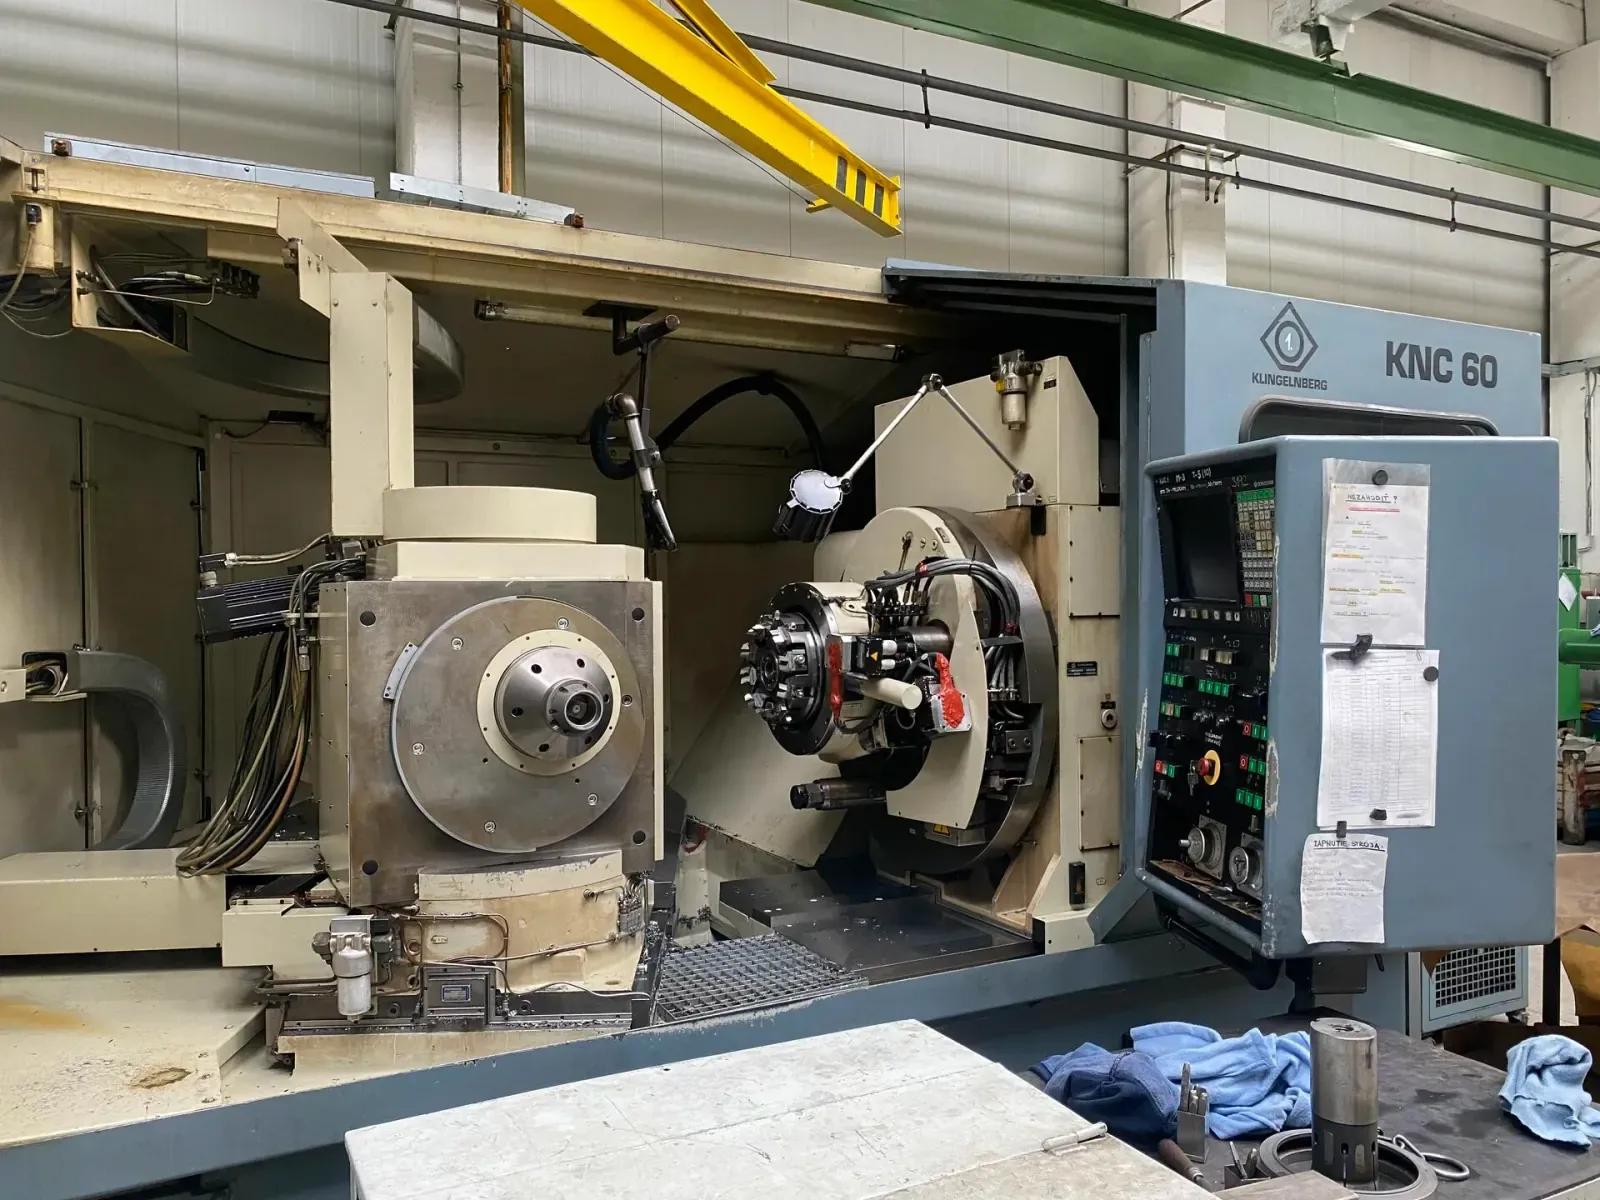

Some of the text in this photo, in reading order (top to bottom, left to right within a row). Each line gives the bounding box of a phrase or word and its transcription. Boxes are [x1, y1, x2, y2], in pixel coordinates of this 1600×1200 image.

[1251, 371, 1328, 391] KLINGELNBERG
[1385, 340, 1498, 389] KNC 60
